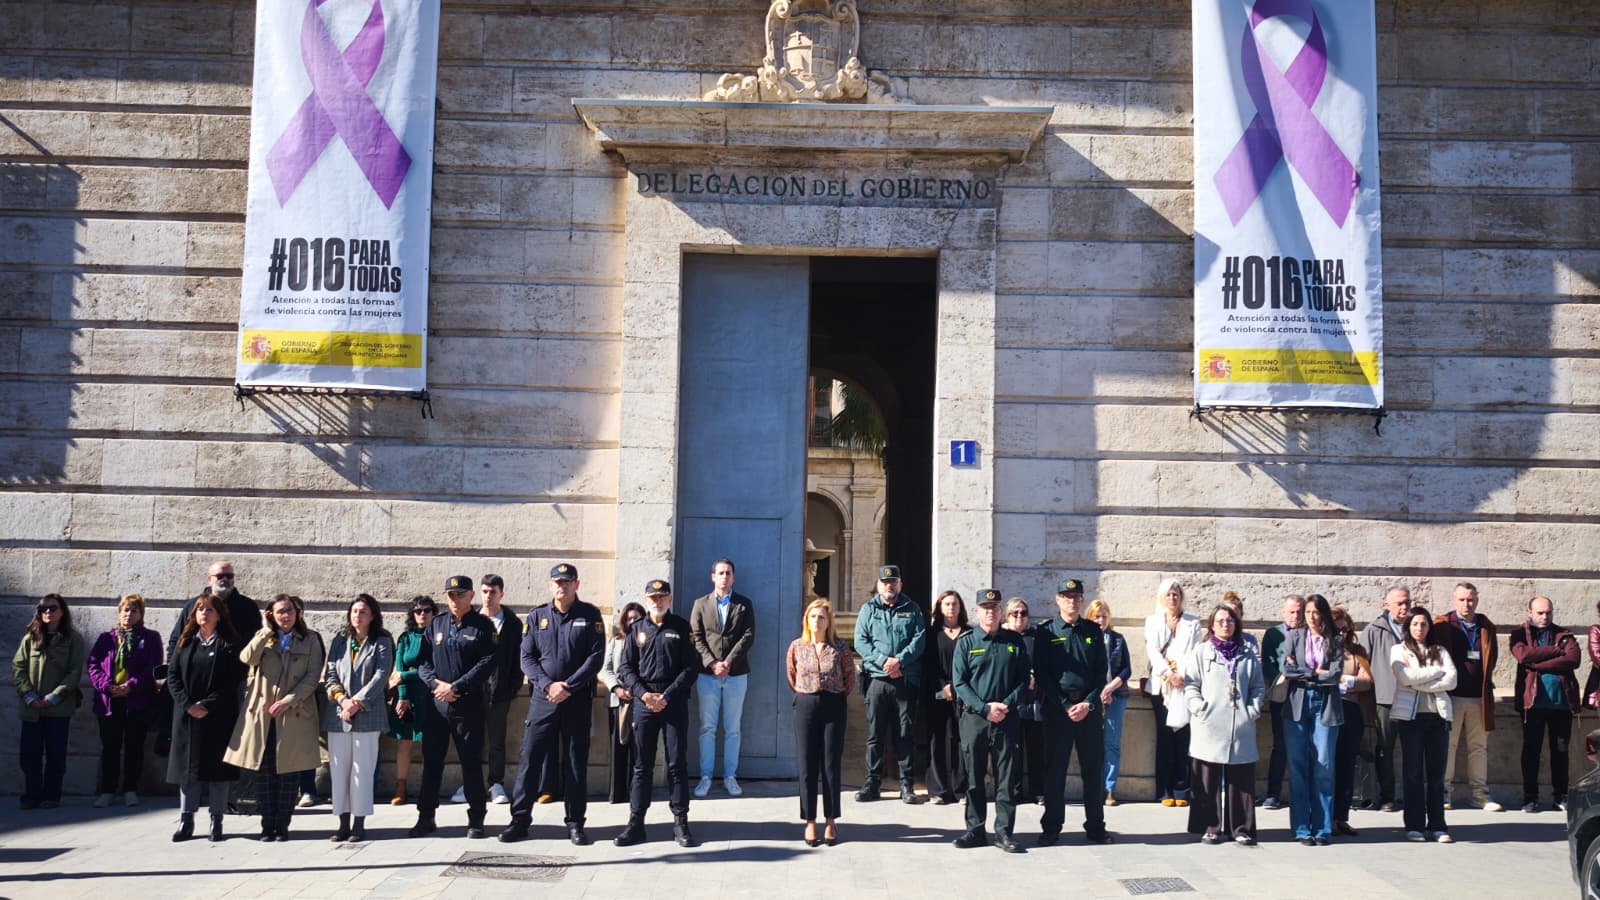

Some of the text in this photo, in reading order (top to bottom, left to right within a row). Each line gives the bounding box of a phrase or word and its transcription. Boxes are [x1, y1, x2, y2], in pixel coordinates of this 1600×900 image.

[813, 179, 854, 197] DEL
[860, 178, 991, 200] GOBIERNO
[348, 239, 392, 266] PARA
[268, 238, 345, 292] #016
[1302, 259, 1346, 285] PARA
[348, 266, 402, 293] TODAS
[1222, 256, 1303, 310] #016
[322, 296, 345, 304] todas
[348, 297, 360, 305] las
[362, 297, 396, 306] formas
[1305, 285, 1357, 312] TODAS
[278, 307, 316, 315] violencia
[318, 308, 347, 316] contra
[350, 308, 362, 316] las
[364, 309, 402, 319] mujeres
[1228, 314, 1271, 322] Atención
[1281, 314, 1306, 322] todas
[1308, 315, 1318, 323] las
[1320, 316, 1350, 325] formas
[1220, 325, 1358, 337] de violencia contra las mujeres
[957, 443, 966, 464] 1
